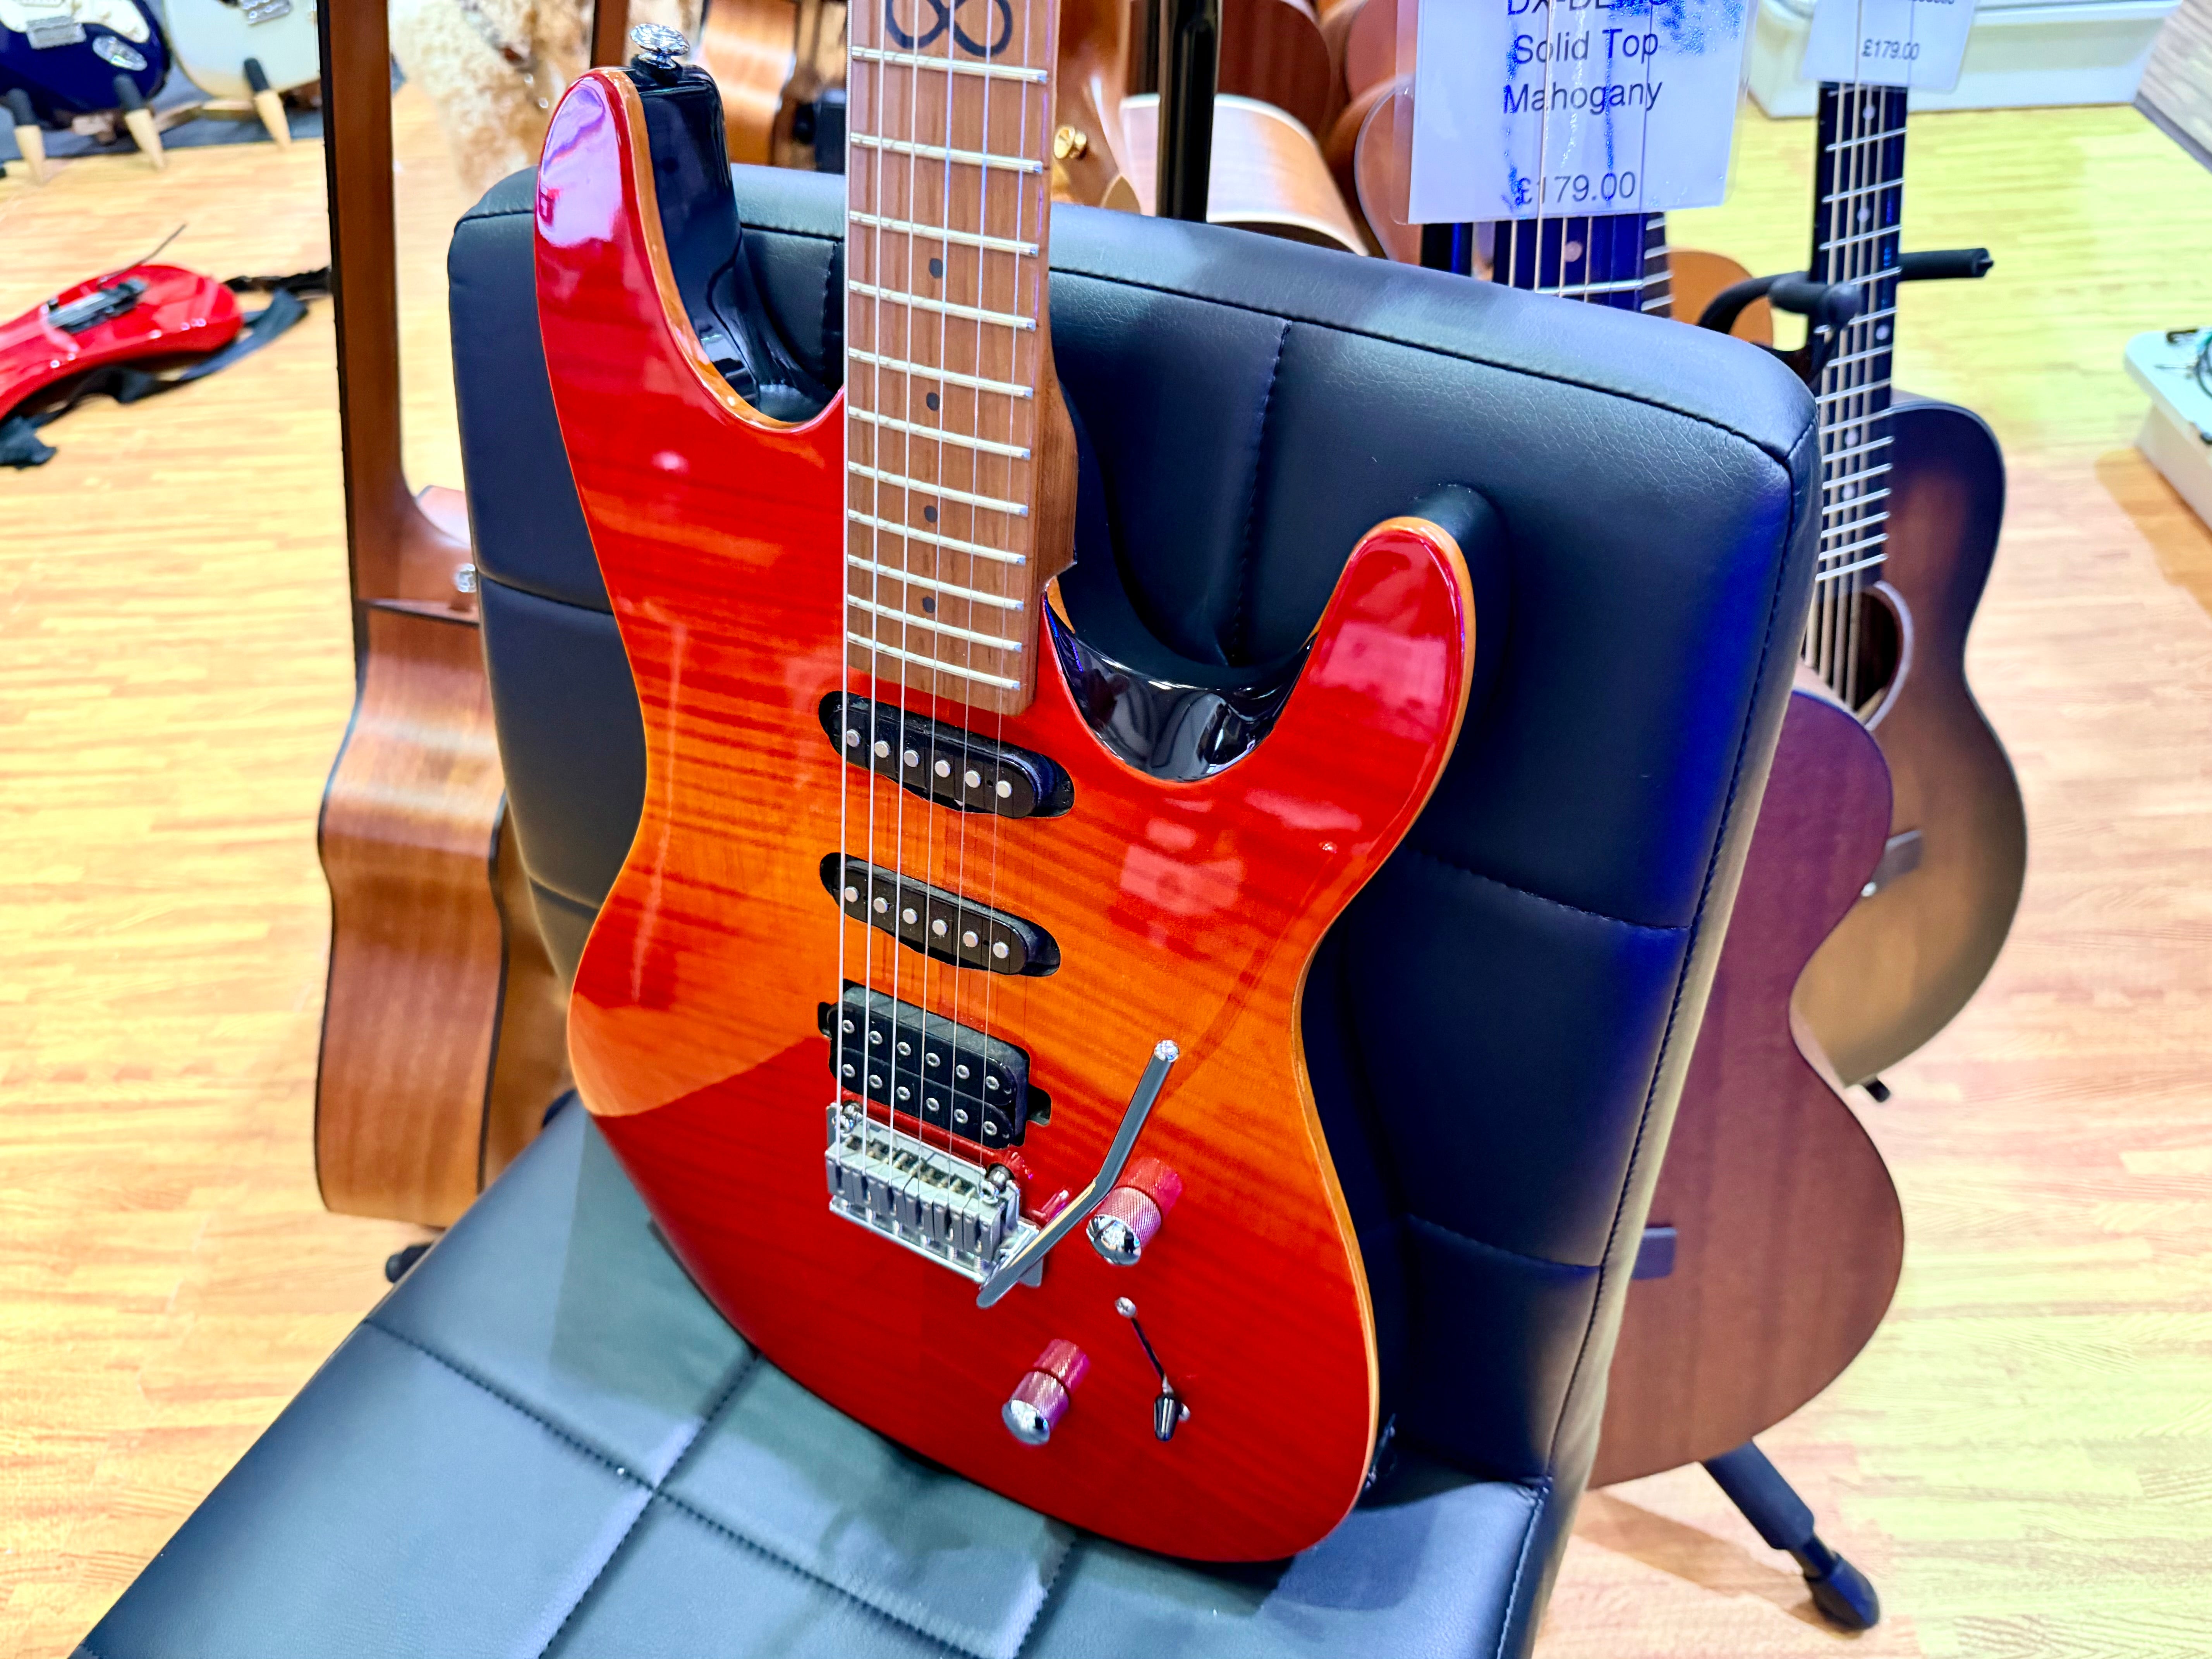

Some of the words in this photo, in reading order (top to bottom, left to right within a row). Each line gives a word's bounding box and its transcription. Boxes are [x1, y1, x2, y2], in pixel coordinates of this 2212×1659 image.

[1516, 30, 1589, 64] Solid
[1602, 28, 1658, 64] Top
[1862, 39, 1920, 60] £179.00
[1503, 81, 1663, 115] Mahogany
[1515, 171, 1636, 204] £179.00
